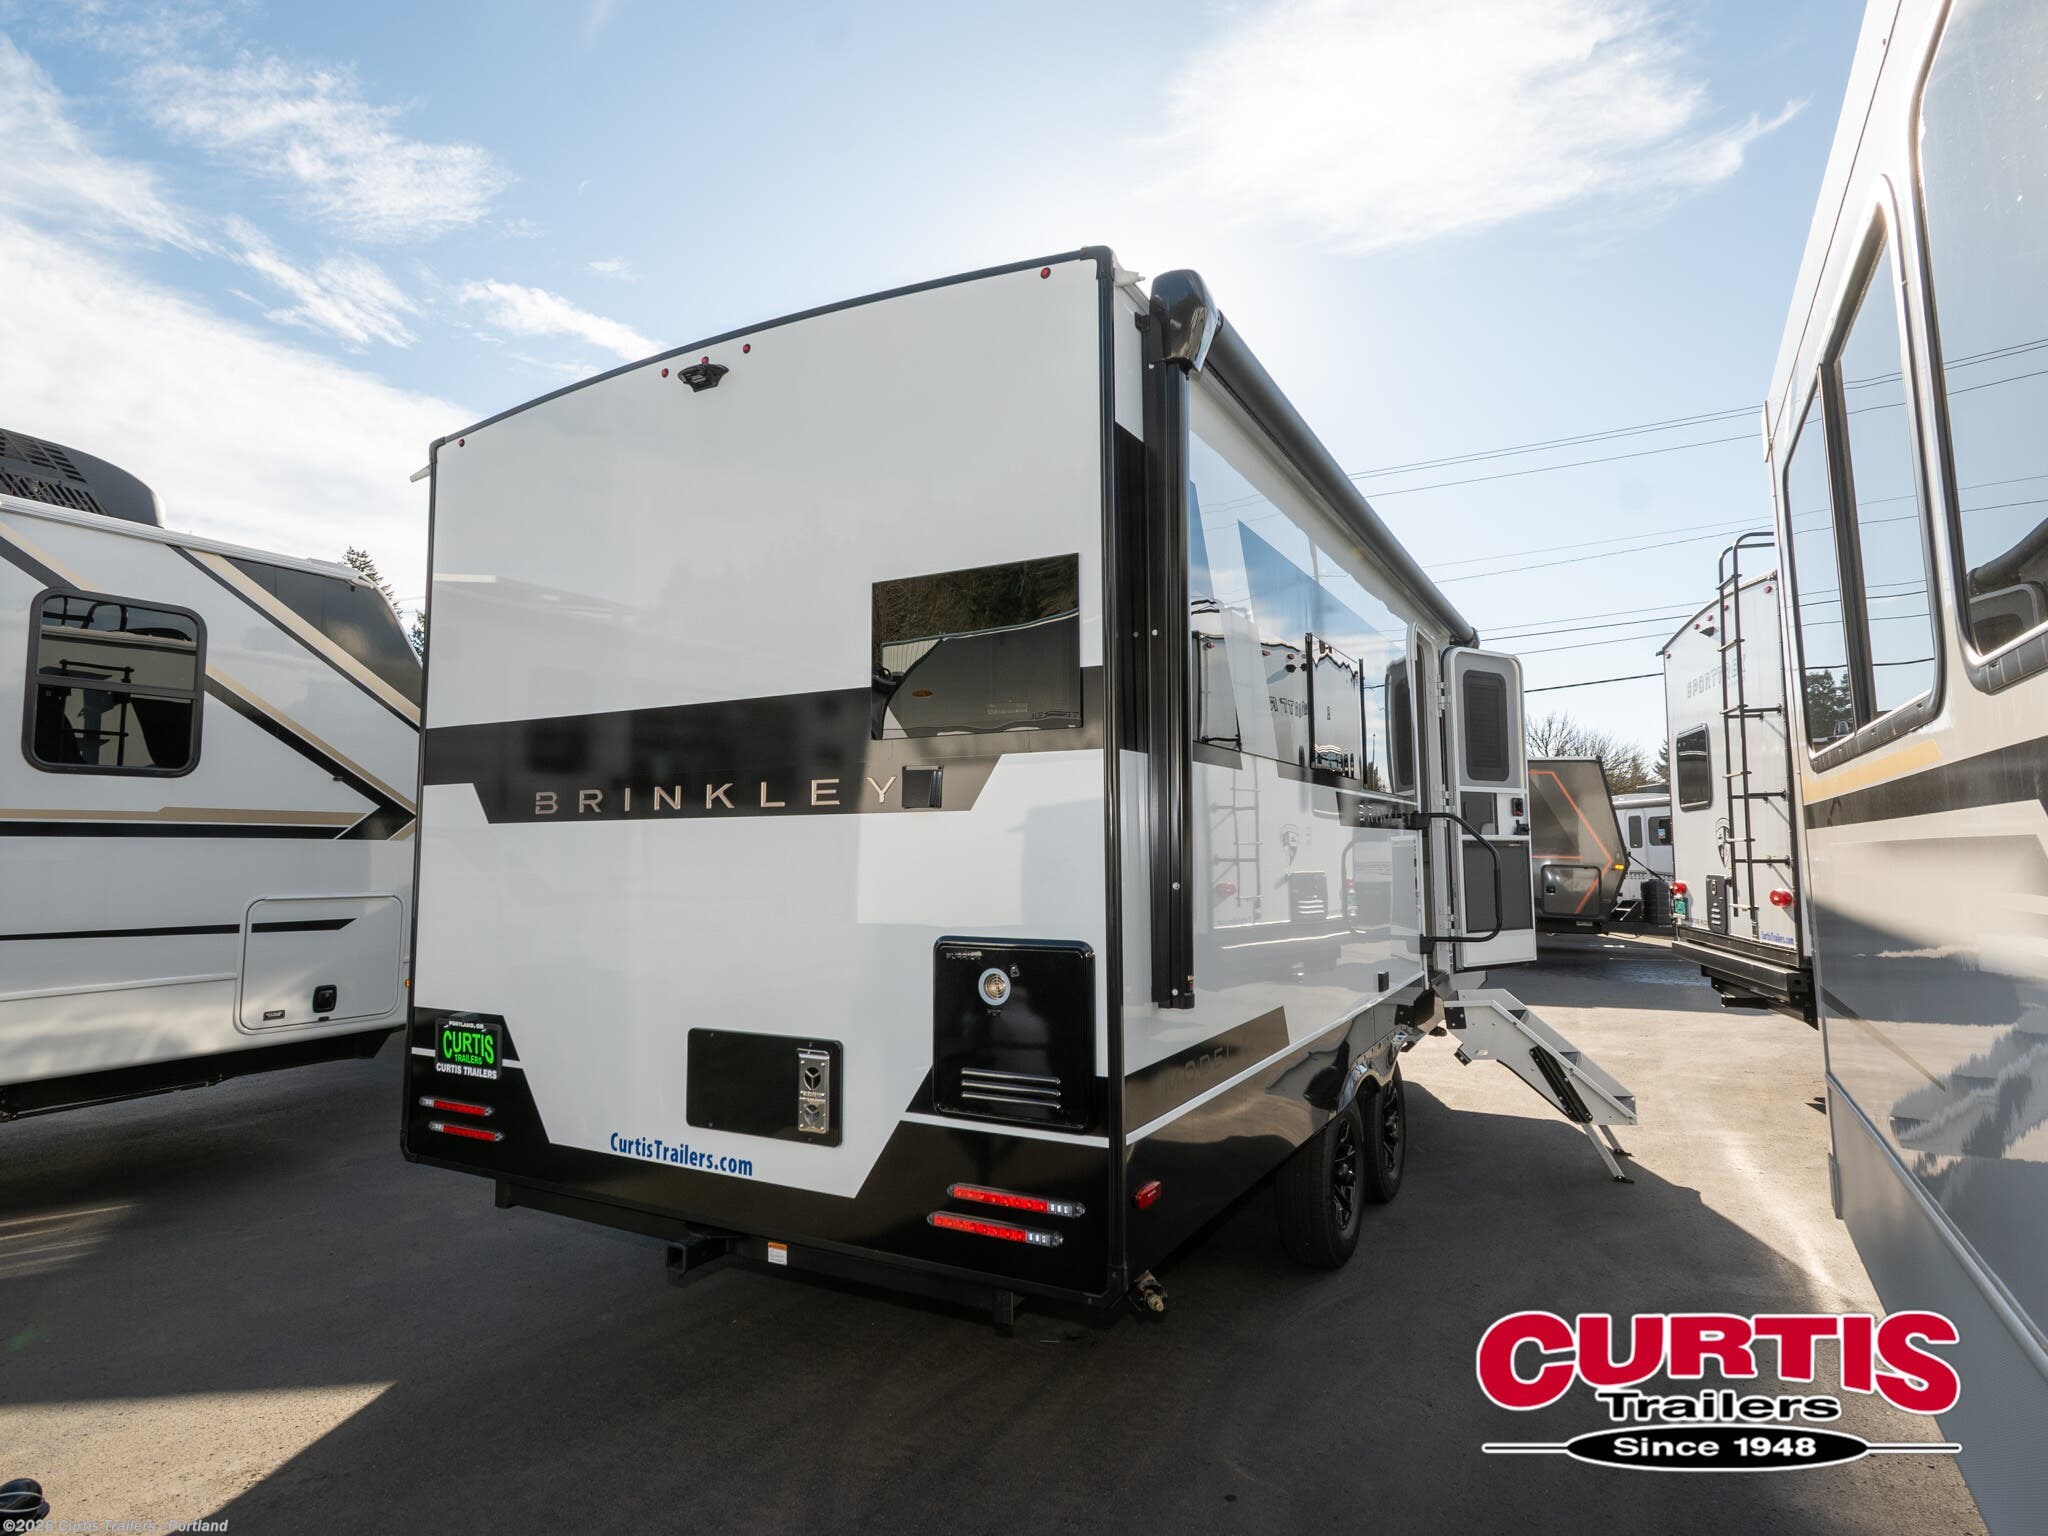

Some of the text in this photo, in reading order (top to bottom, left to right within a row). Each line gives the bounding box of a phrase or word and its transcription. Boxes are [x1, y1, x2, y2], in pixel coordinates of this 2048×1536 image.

[535, 775, 898, 815] BRINKLEY
[443, 1030, 494, 1064] CURTIS
[455, 1054, 483, 1065] TRAILERS
[436, 1062, 497, 1080] CURTIS TRAILERS
[610, 1132, 753, 1176] CurtisTrailers.com
